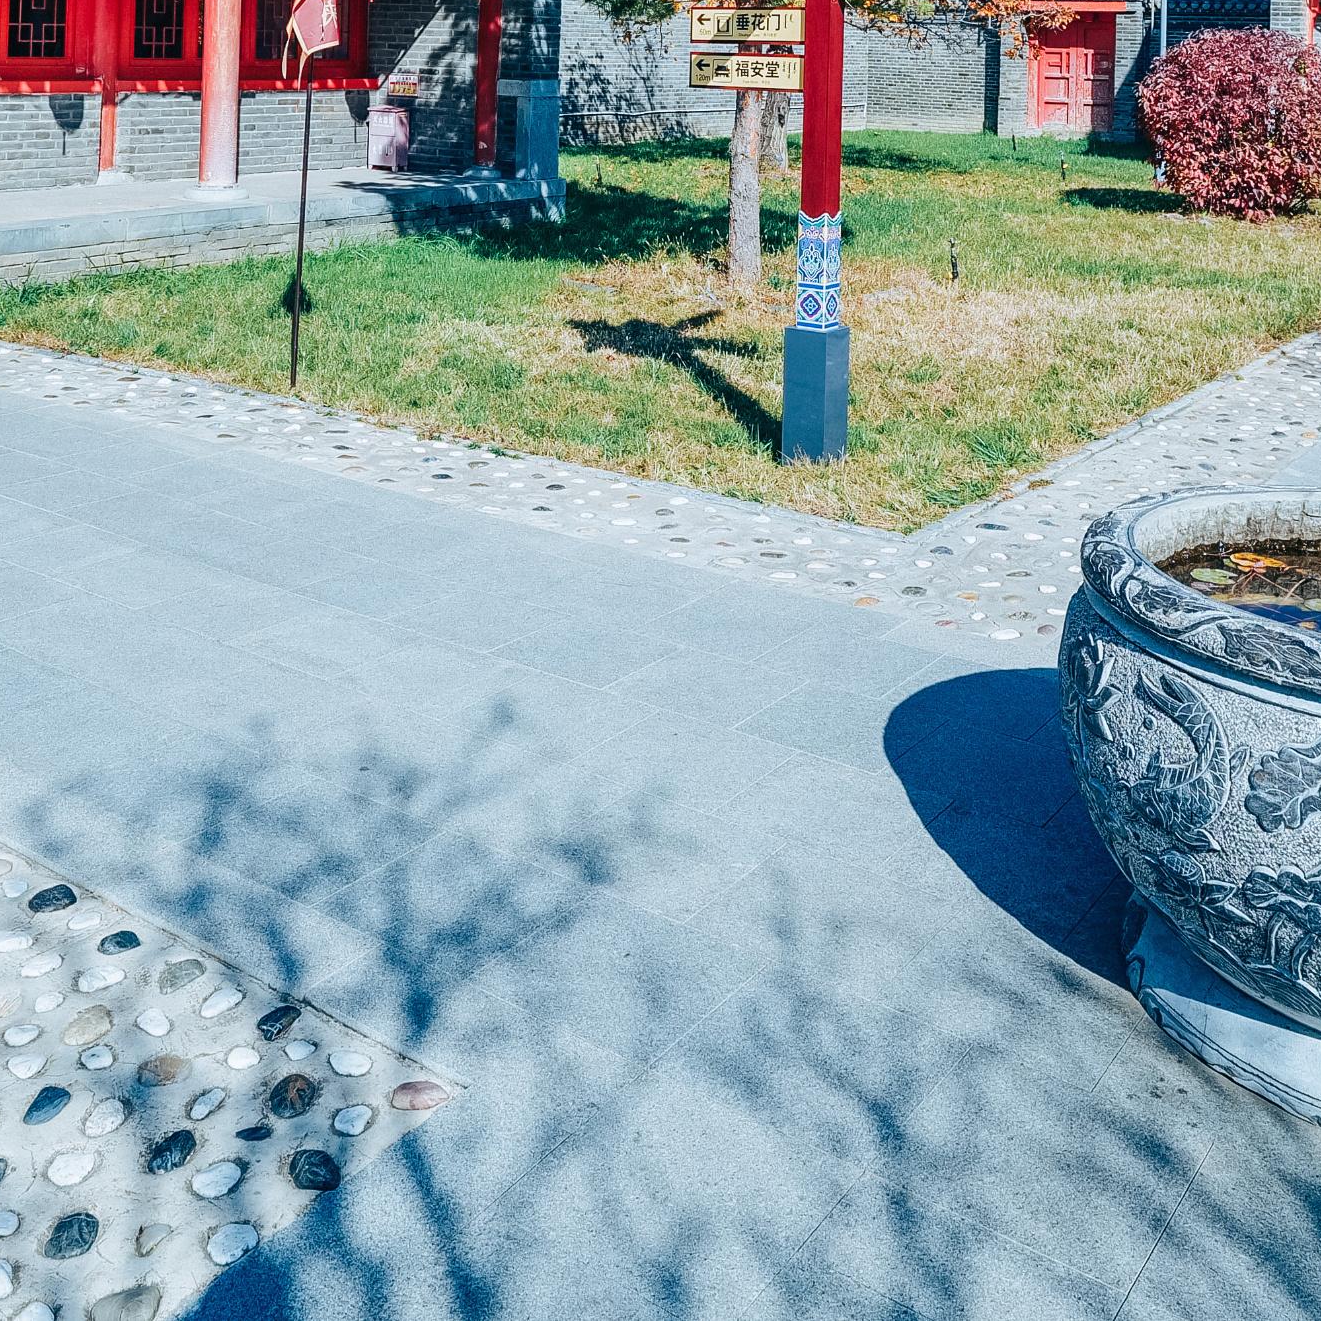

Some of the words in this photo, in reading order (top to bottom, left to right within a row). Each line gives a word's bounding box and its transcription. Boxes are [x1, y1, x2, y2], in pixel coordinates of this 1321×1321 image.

[736, 13, 781, 31] 垂花门
[695, 73, 711, 82] 120m
[735, 60, 780, 78] 福安堂
